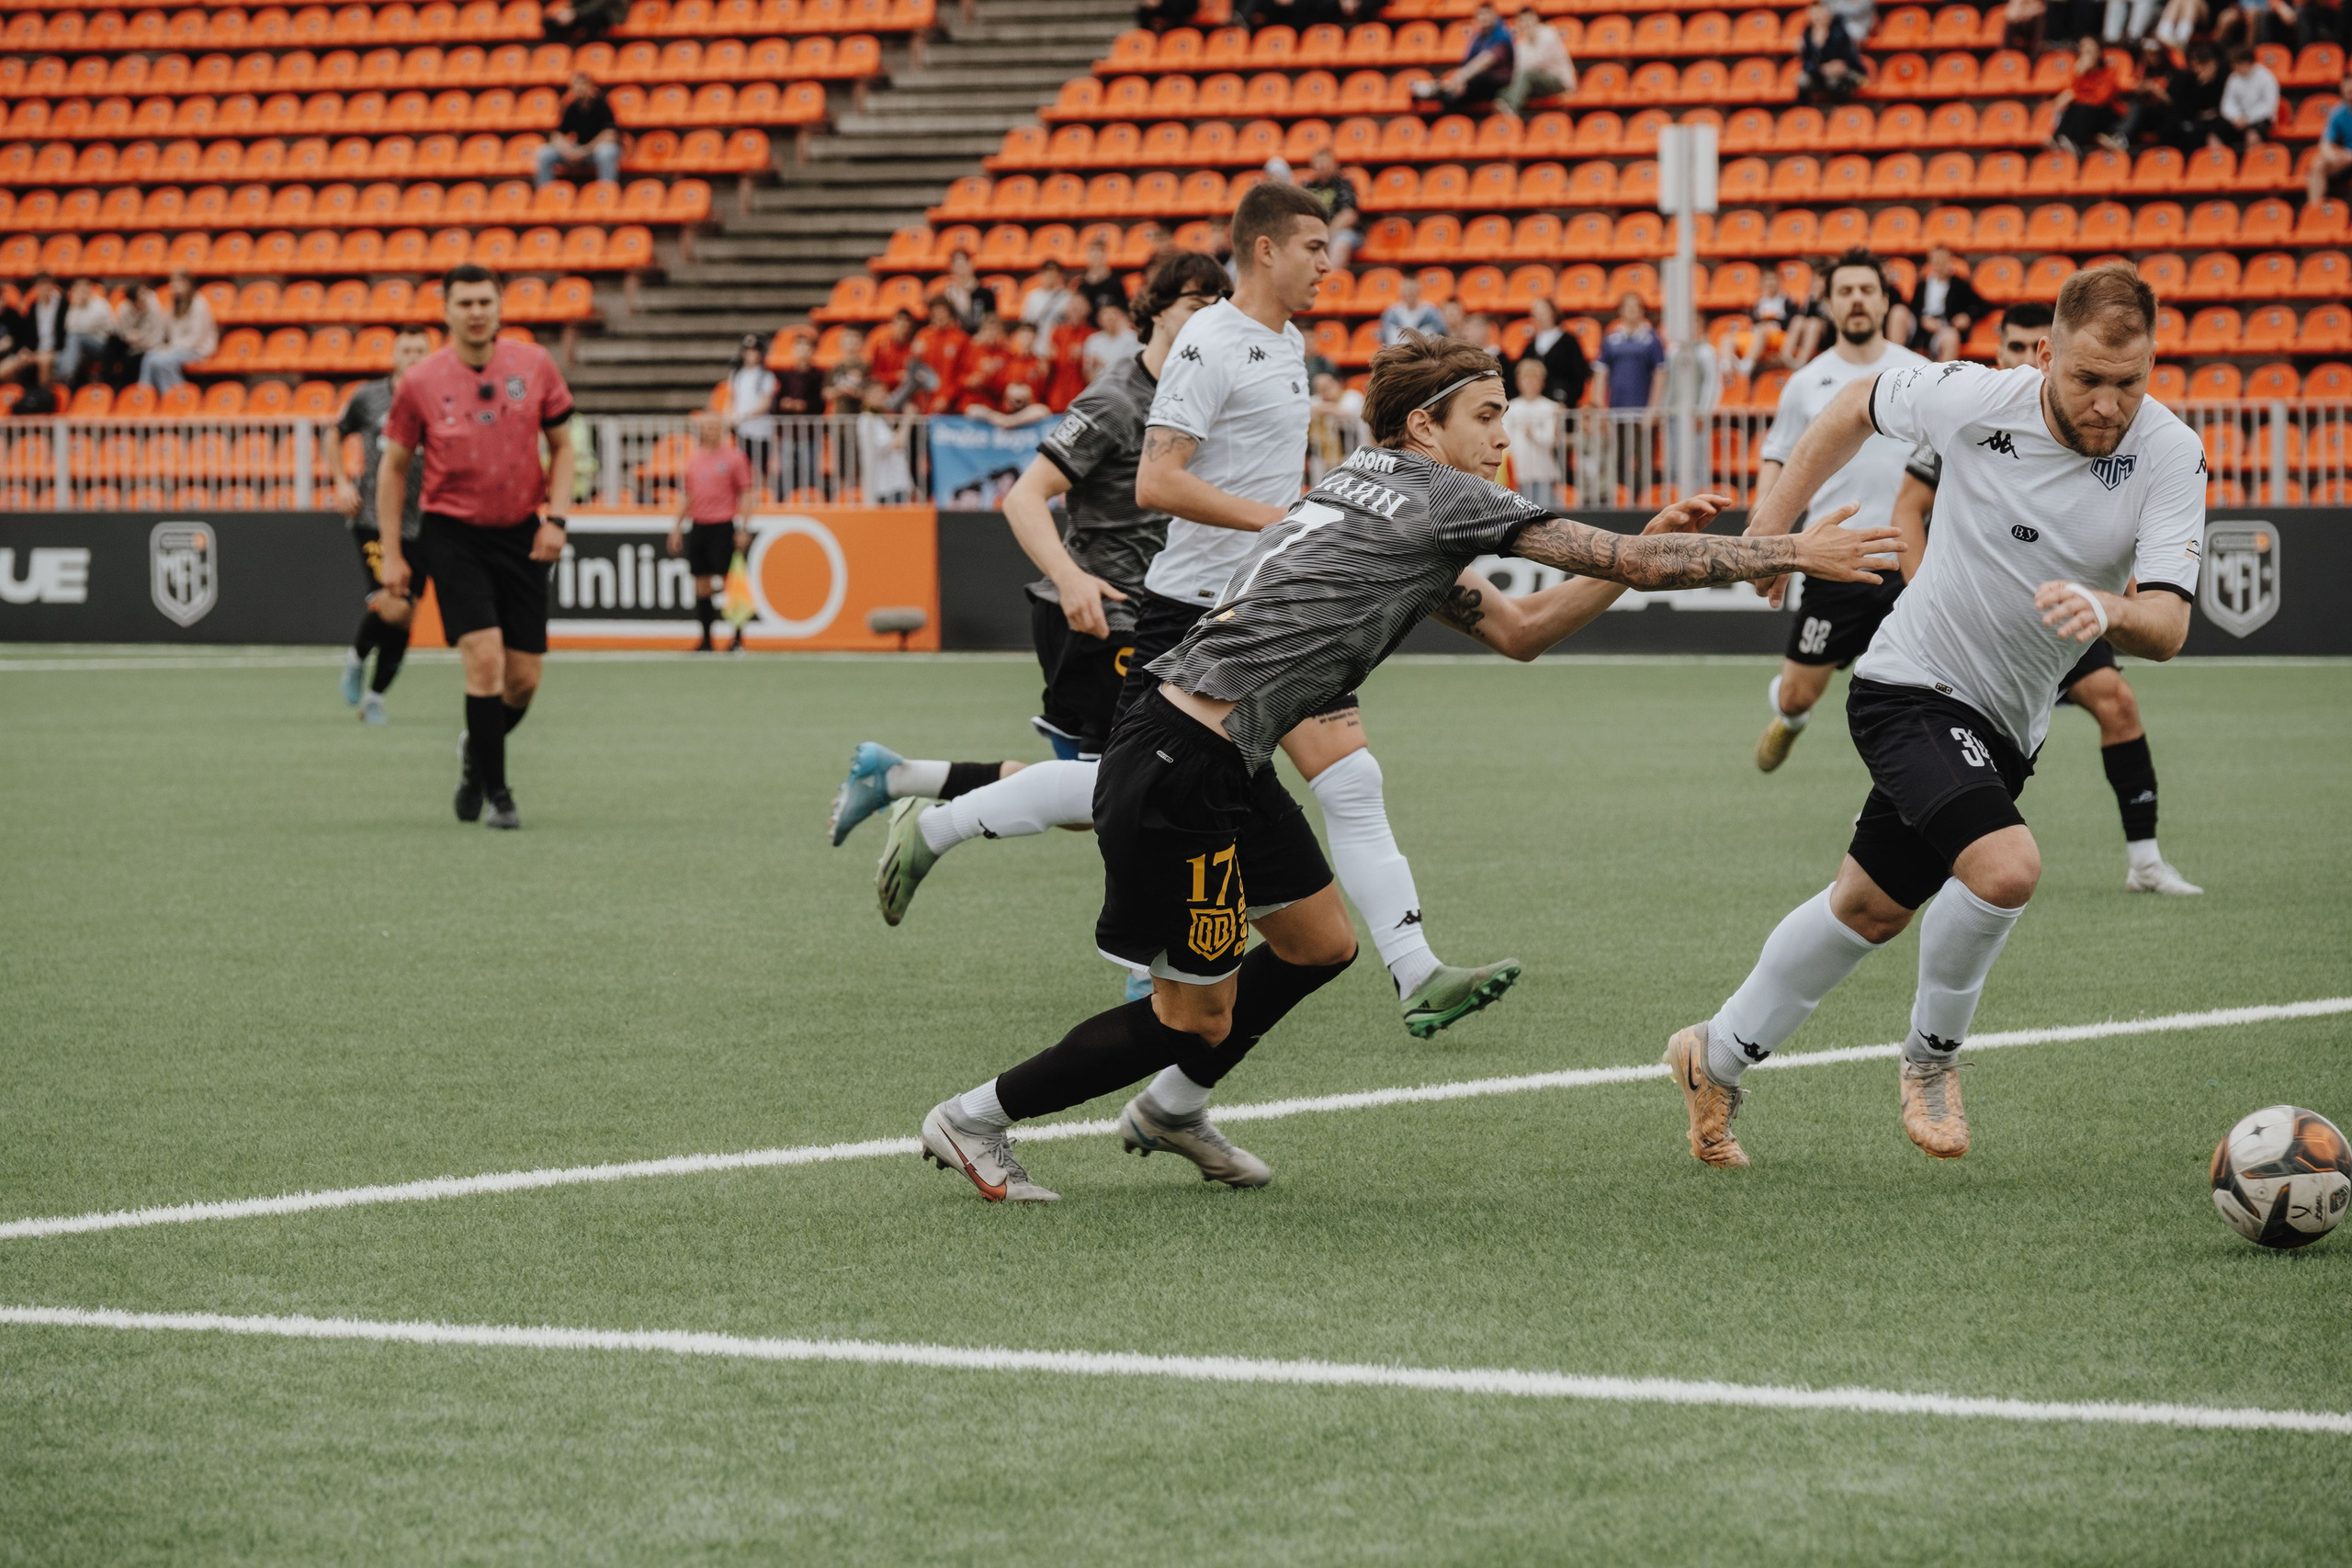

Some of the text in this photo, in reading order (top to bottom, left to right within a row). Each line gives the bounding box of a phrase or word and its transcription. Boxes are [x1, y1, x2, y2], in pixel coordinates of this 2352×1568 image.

[0, 547, 90, 604] UE
[549, 543, 729, 611] inlin
[1214, 500, 1345, 610] 7
[1799, 616, 1832, 654] 92
[1186, 843, 1236, 907] 17
